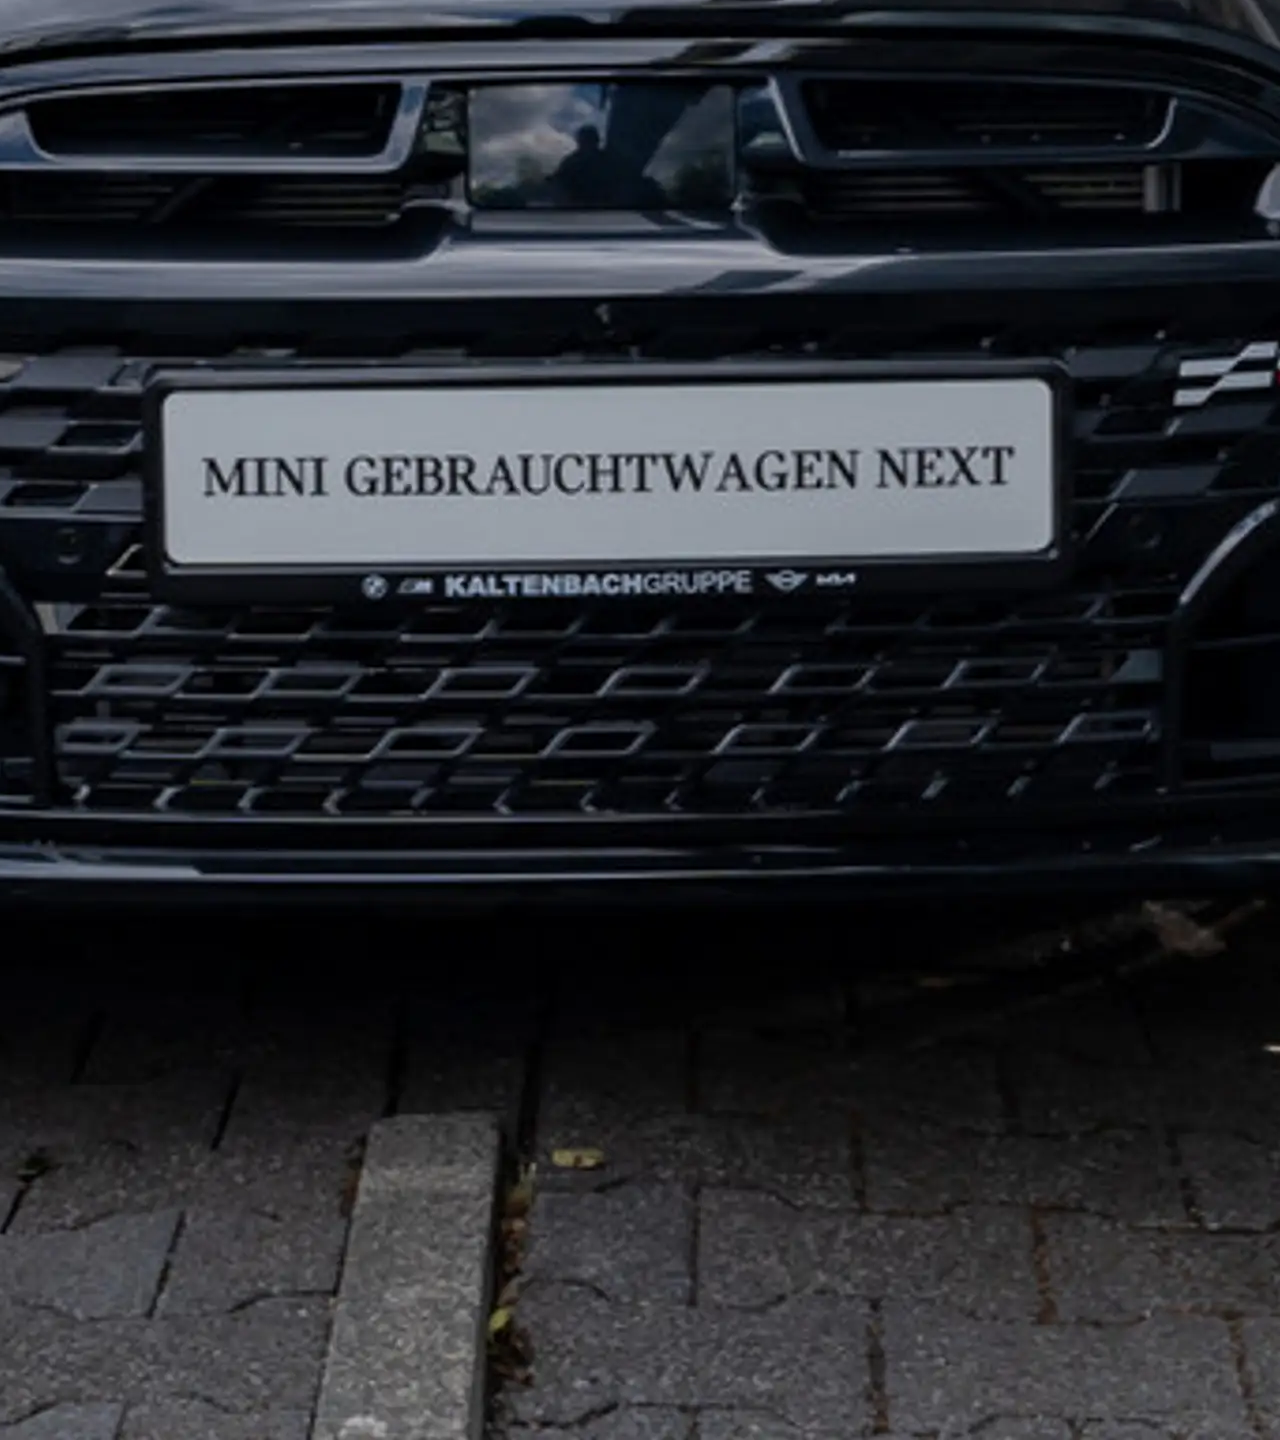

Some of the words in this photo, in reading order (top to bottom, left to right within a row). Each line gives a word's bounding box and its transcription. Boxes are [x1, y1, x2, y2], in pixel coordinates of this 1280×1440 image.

[202, 456, 329, 497] MINI
[344, 449, 860, 497] GEBRAUCHTWAGEN
[875, 446, 1016, 489] NEXT
[444, 570, 753, 598] KALTENBACHGRUPPE
